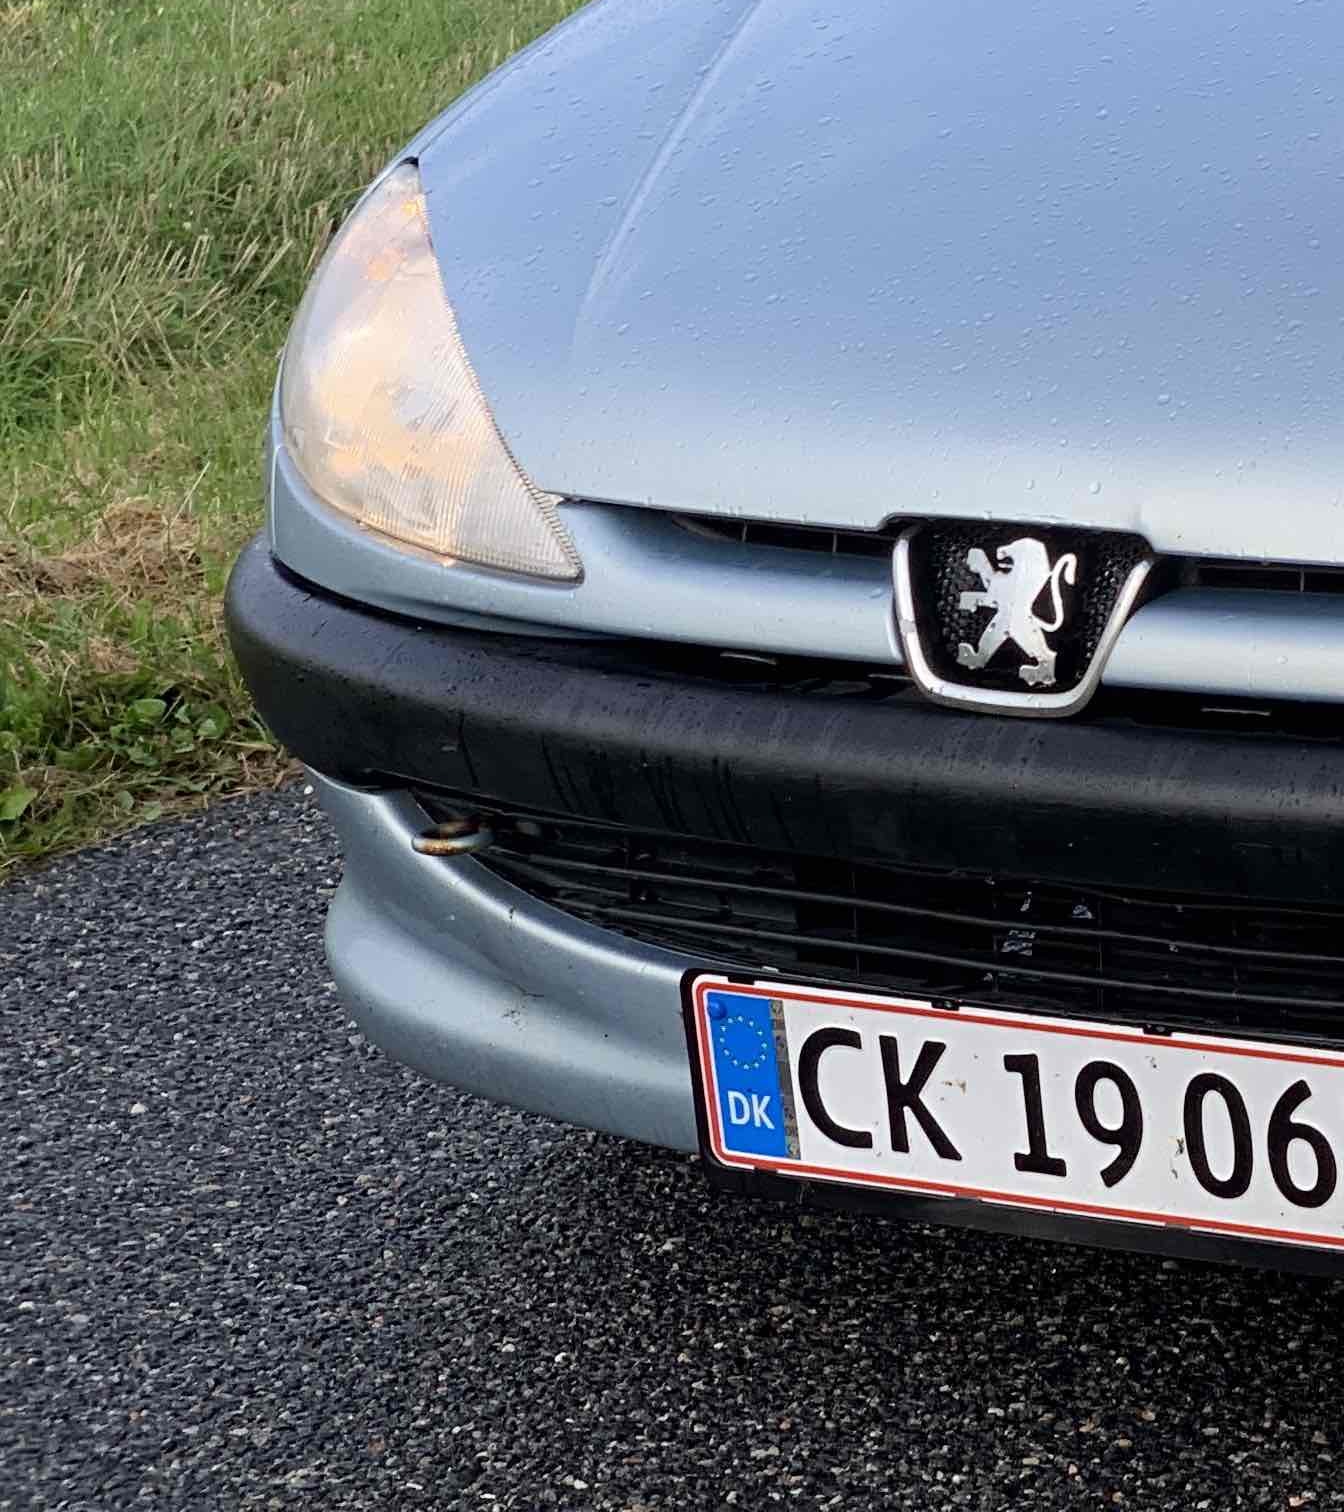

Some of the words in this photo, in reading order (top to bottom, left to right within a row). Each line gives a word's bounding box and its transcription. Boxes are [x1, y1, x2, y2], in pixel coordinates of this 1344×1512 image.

[727, 1090, 776, 1130] DK
[797, 1027, 963, 1162] CK
[1003, 1053, 1144, 1189] 19
